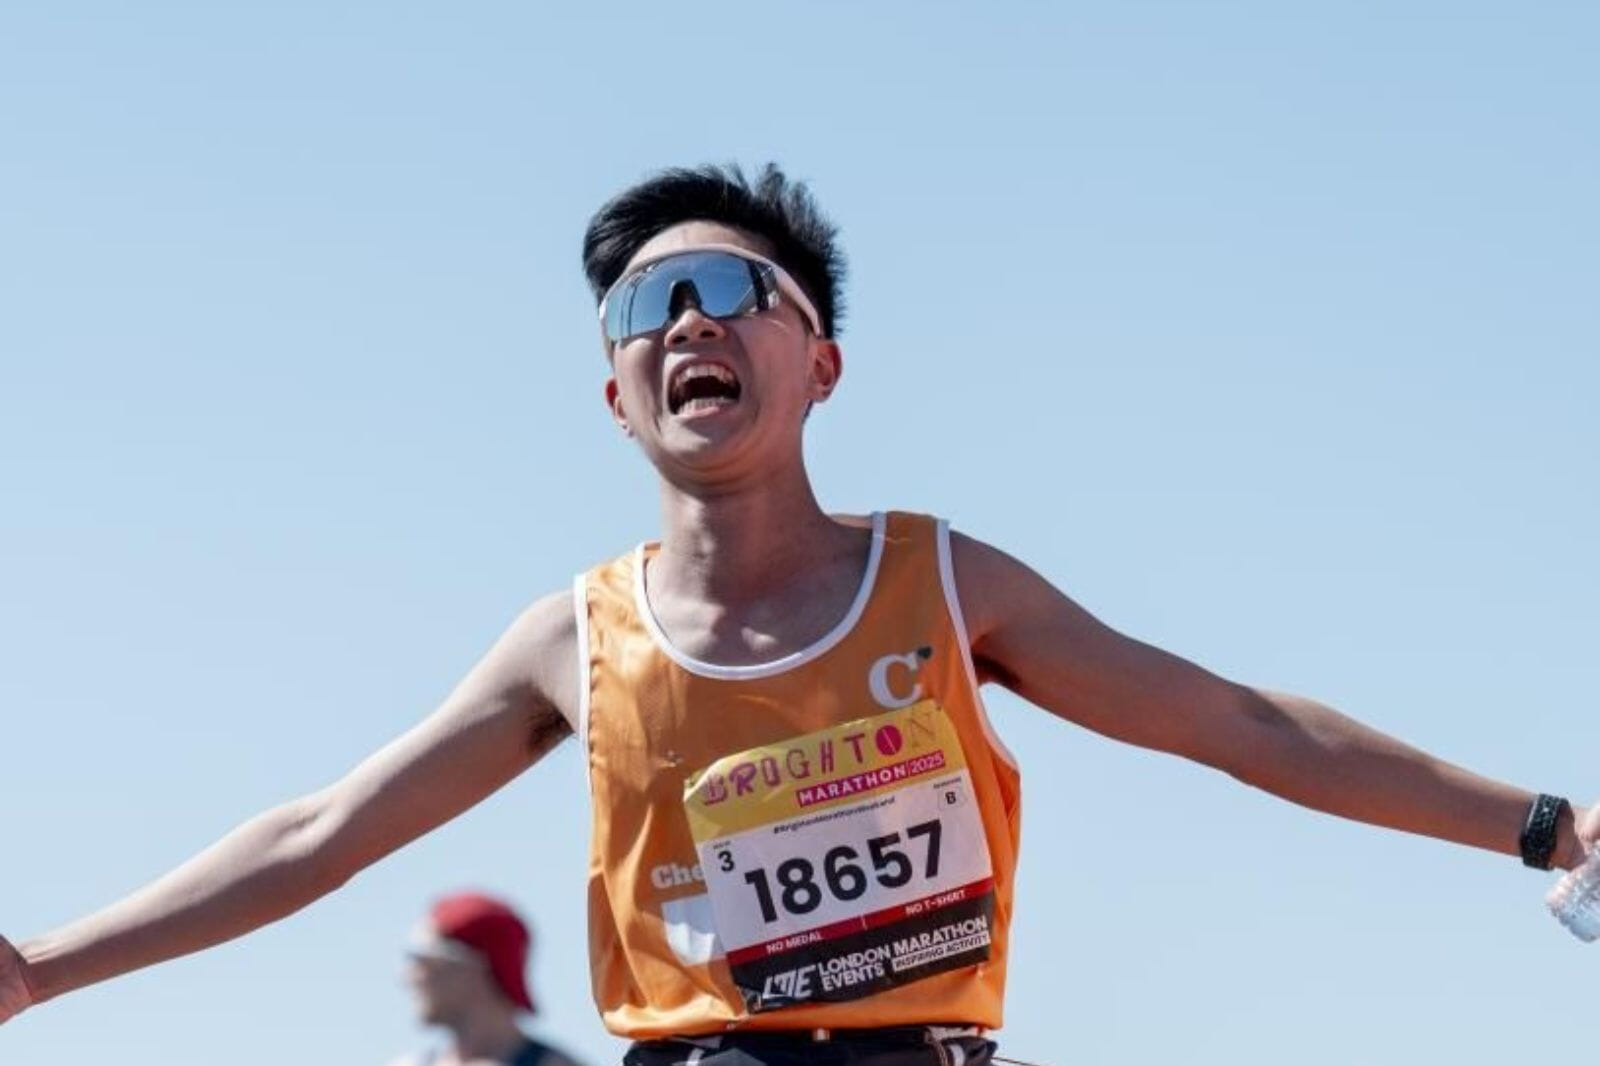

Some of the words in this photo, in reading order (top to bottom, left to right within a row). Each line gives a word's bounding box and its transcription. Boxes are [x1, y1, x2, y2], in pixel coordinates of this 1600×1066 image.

[704, 710, 937, 806] BRIGHTON
[799, 765, 907, 806] MARATHON
[909, 754, 945, 775] 2025
[945, 791, 957, 805] B
[717, 850, 735, 873] 3
[744, 818, 943, 924] 18657
[905, 903, 922, 915] NO
[924, 889, 967, 910] T-SHIRT
[766, 941, 784, 954] NO
[786, 930, 823, 949] MEDAL
[818, 945, 891, 977] LONDON
[893, 915, 988, 957] MARATHON
[894, 945, 946, 969] INSPIRING
[947, 931, 989, 956] ACTIVITY
[821, 963, 885, 992] EVENTS
